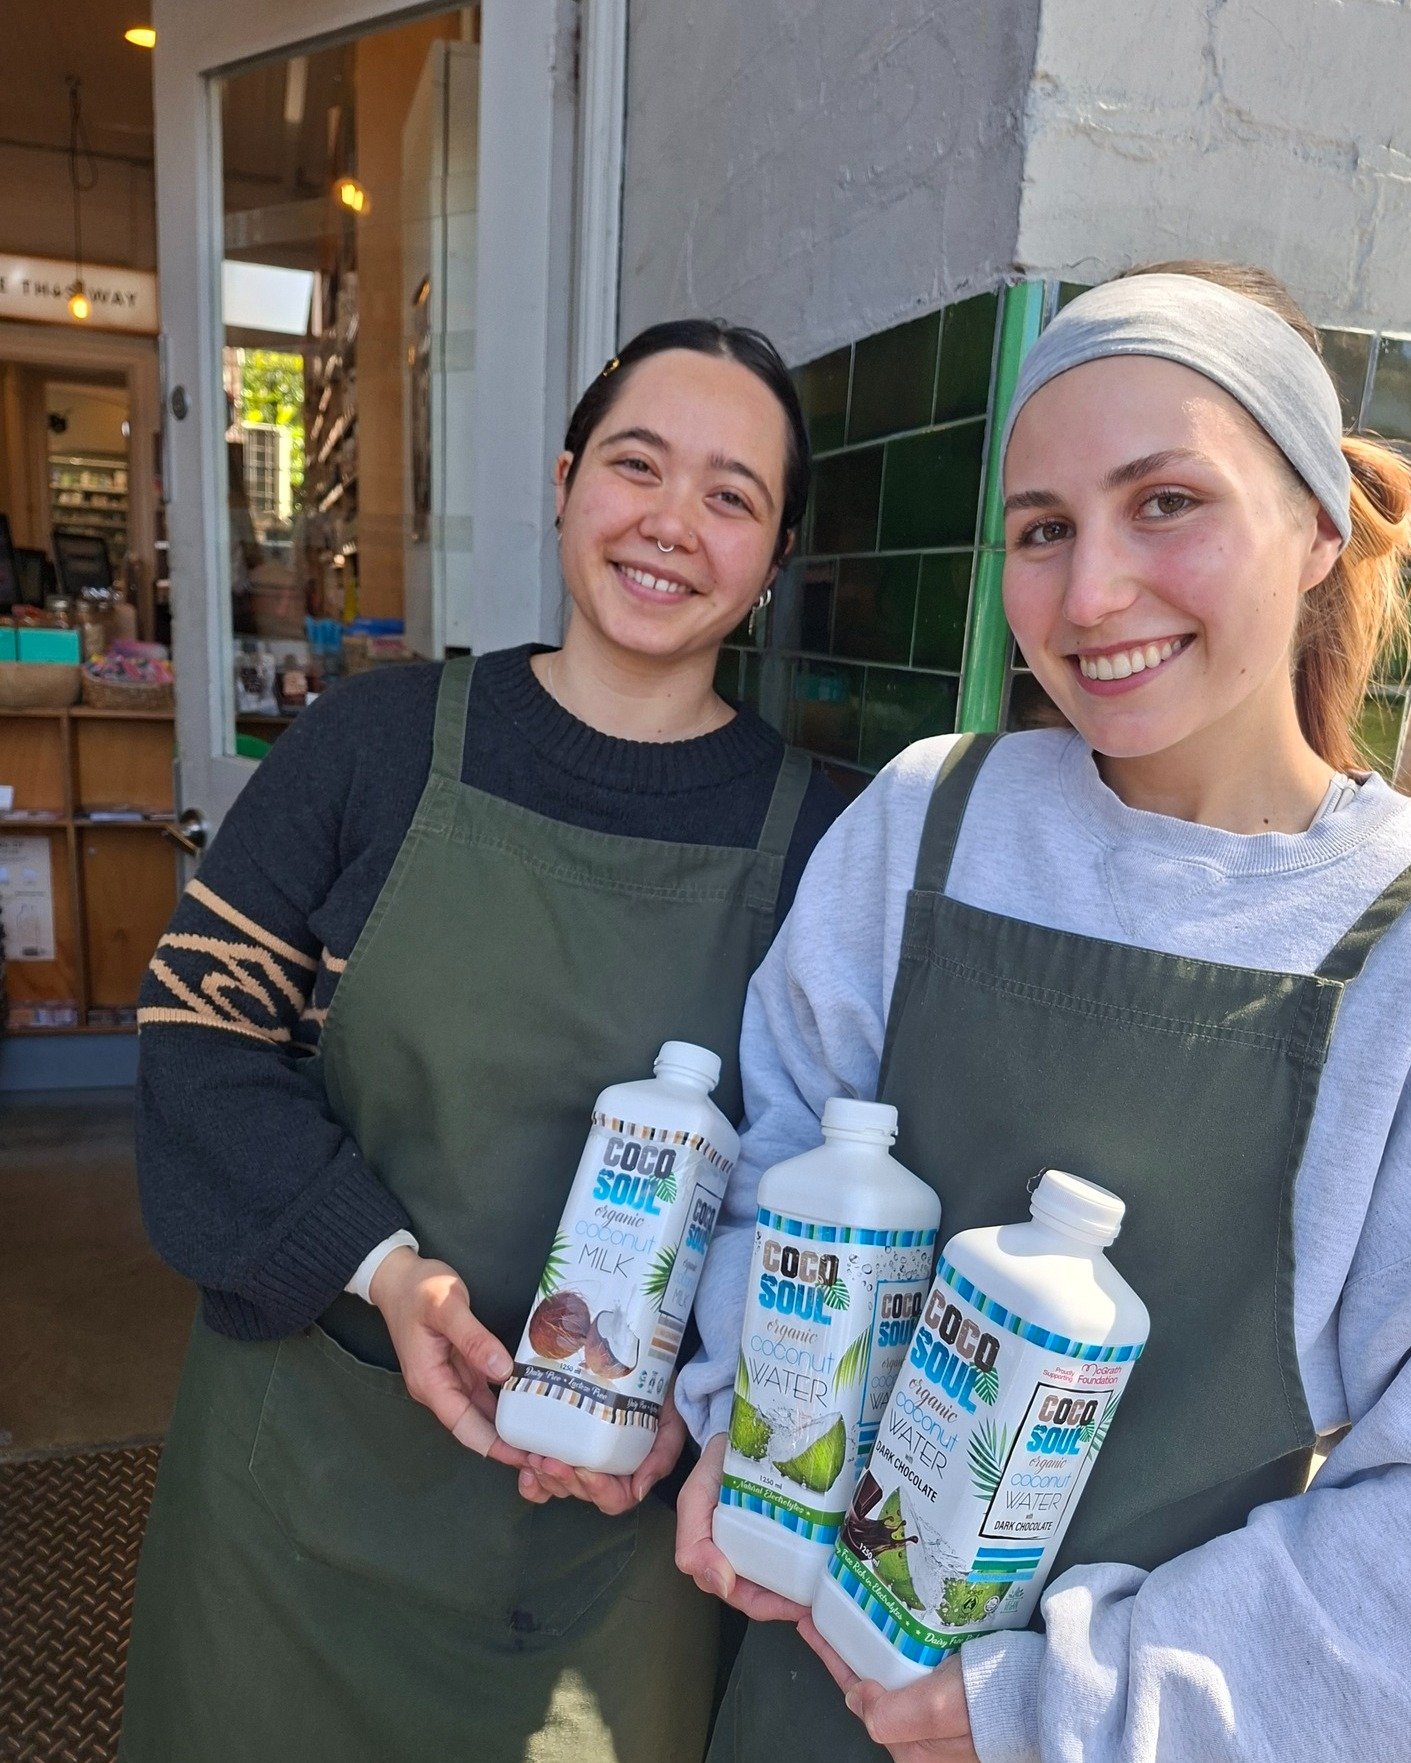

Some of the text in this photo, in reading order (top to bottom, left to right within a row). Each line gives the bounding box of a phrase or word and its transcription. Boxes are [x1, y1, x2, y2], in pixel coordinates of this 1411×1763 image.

[88, 286, 137, 306] WAY
[603, 1136, 676, 1179] COCO
[592, 1168, 661, 1216] SOUL
[595, 1204, 644, 1228] organic
[693, 1198, 716, 1228] COCO
[575, 1220, 656, 1254] coconut
[578, 1244, 634, 1278] MILK
[762, 1239, 839, 1286] COCO
[758, 1273, 832, 1326] SOUL
[881, 1292, 922, 1319] COCO
[766, 1320, 819, 1345] organic
[924, 1288, 1000, 1373] COCO
[750, 1335, 835, 1374] coconut
[1081, 1363, 1122, 1377] McGrath
[525, 1365, 544, 1379] Dairy
[748, 1357, 828, 1408] WATER
[910, 1326, 978, 1416] SOUL
[1042, 1369, 1074, 1384] Supporting
[1055, 1366, 1076, 1377] Proudly
[1077, 1375, 1119, 1385] Foundation
[908, 1377, 959, 1424] organic
[1038, 1394, 1098, 1427] COCO
[895, 1391, 958, 1451] coconut
[889, 1407, 948, 1480] WATER
[1026, 1423, 1083, 1455] SOUL
[875, 1440, 938, 1504] DARK CHOCOLATE
[1010, 1472, 1072, 1489] coconut
[1029, 1456, 1067, 1474] organic
[736, 1480, 805, 1514] Natural Electrolytes
[760, 1475, 783, 1490] 1250 ml
[1005, 1490, 1062, 1511] WATER
[994, 1520, 1053, 1532] DARK CHOCOLATE
[860, 1542, 880, 1568] 1250 ml
[841, 1548, 903, 1621] Free Rich in Electrolytes
[924, 1632, 947, 1649] Dairy
